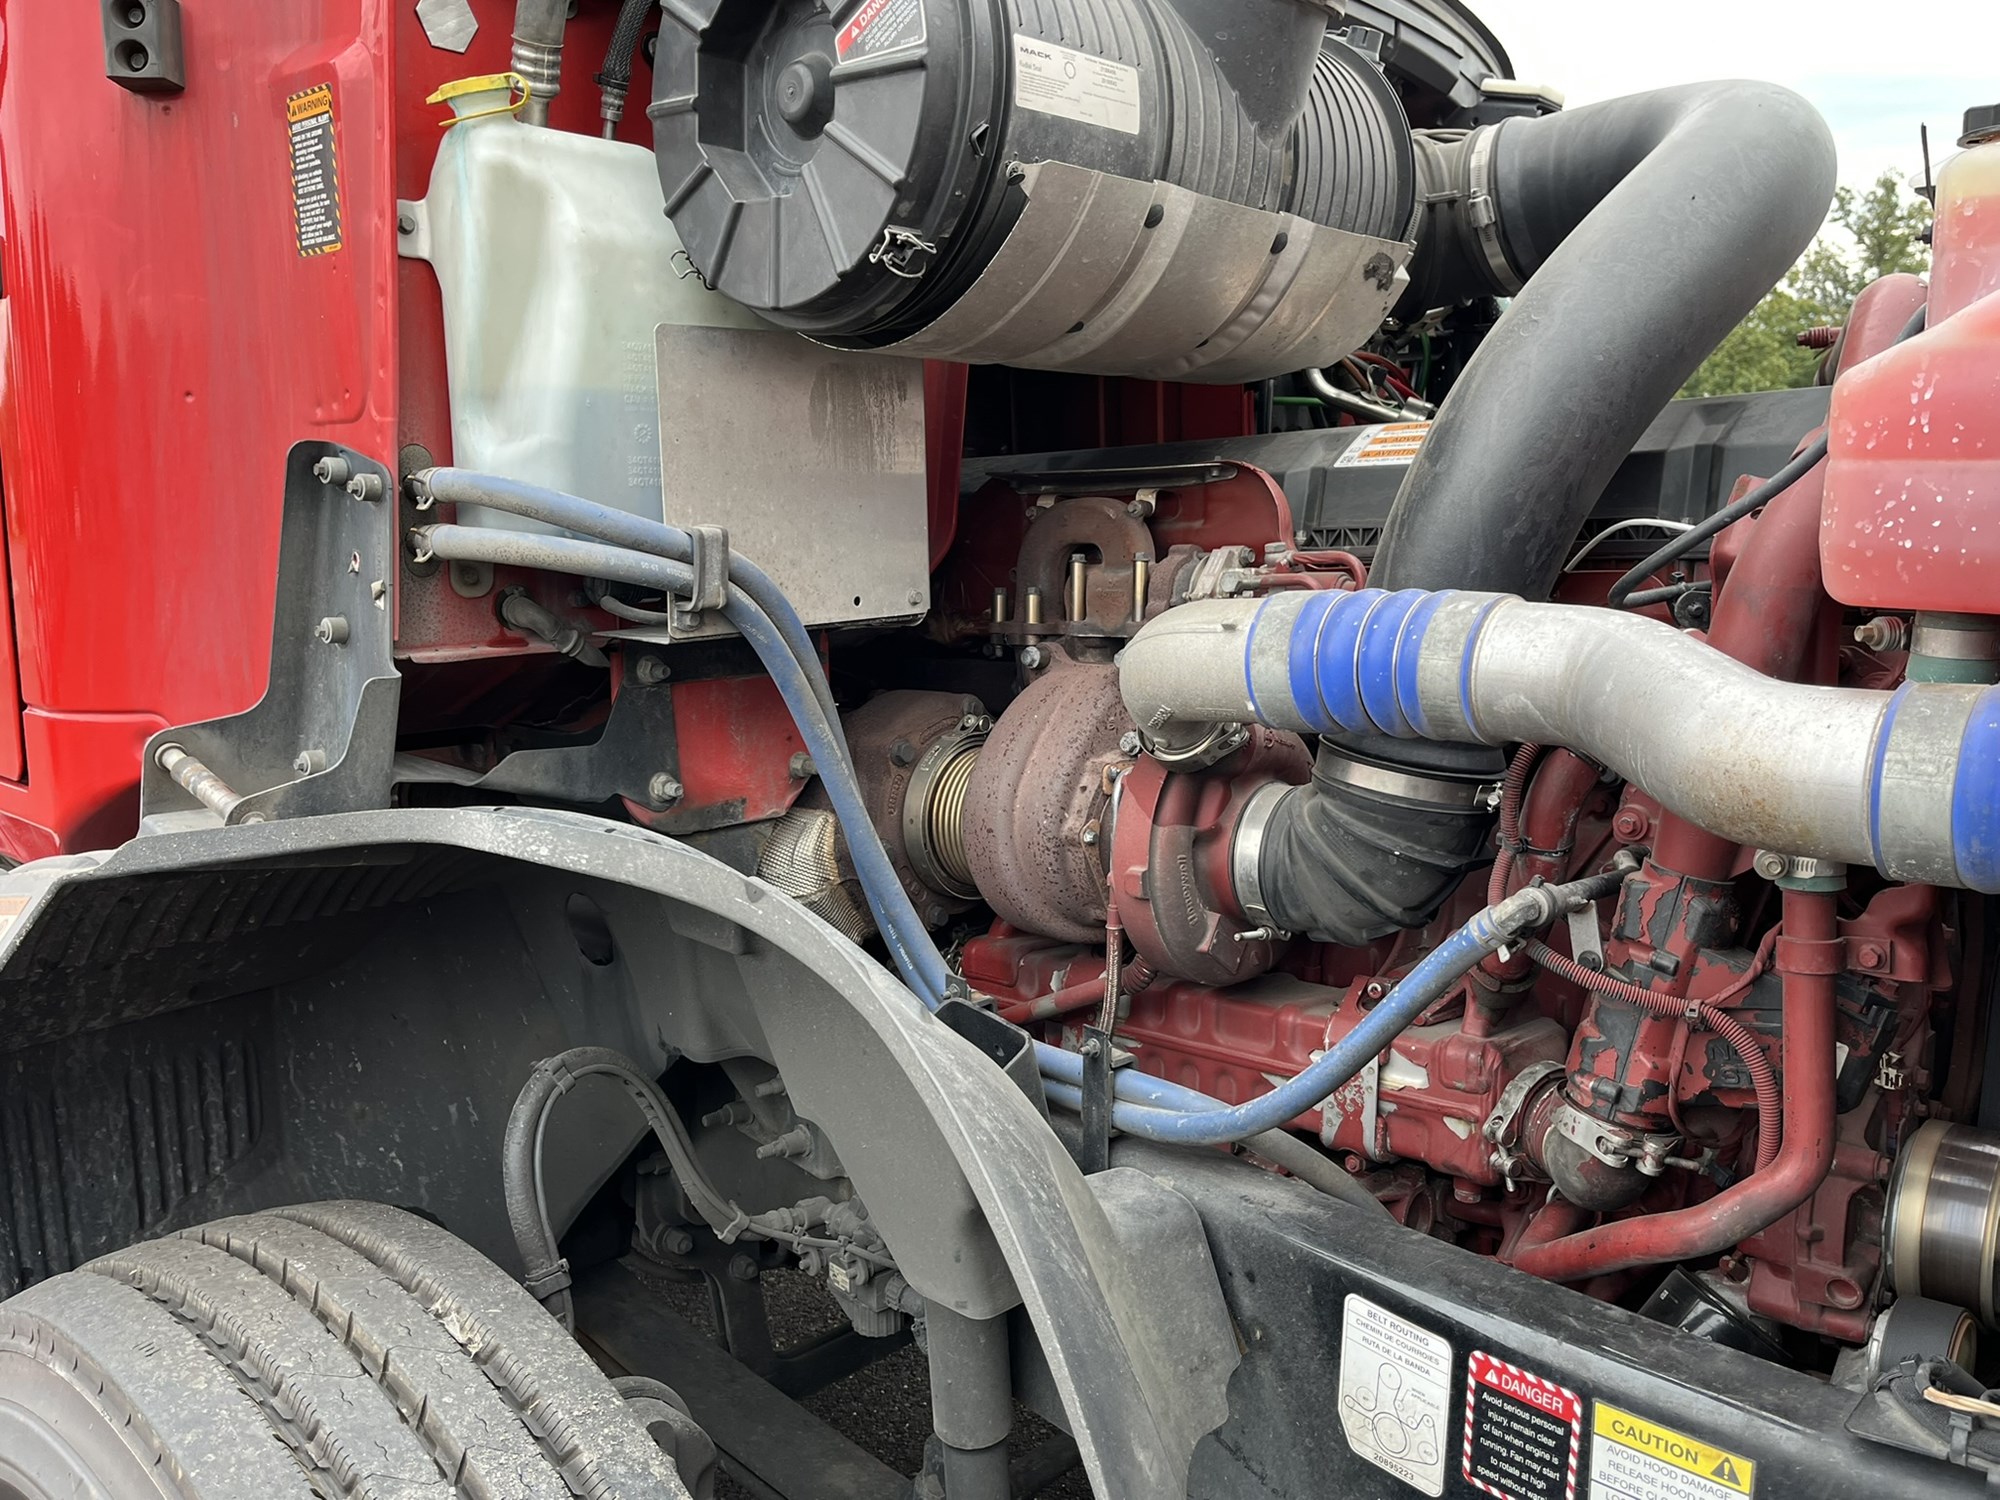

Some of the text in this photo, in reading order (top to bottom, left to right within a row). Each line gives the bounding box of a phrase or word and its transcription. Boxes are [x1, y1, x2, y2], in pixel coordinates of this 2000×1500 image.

[1020, 47, 1052, 60] MACK
[297, 94, 327, 114] WARNING
[1177, 854, 1198, 927] Honeywell
[1356, 1318, 1440, 1366] CHEMIN DE COURROIES
[1367, 1310, 1429, 1347] BELT ROUTING
[1362, 1336, 1431, 1376] RUTA DE LA BANDA
[1482, 1392, 1564, 1436] Avoid serious personal
[1502, 1374, 1563, 1414] DANGER
[1483, 1423, 1559, 1465] of fan when engine is
[1488, 1409, 1556, 1447] injury, remain clear
[1611, 1420, 1698, 1465] CAUTION
[1374, 1453, 1414, 1481] 20895223
[1480, 1437, 1560, 1481] running. Fan may start
[1490, 1456, 1546, 1490] to rotate at high
[1606, 1445, 1732, 1500] AVOID HOOD DAMAGE
[1477, 1465, 1499, 1481] speed
[1500, 1476, 1525, 1495] without
[1599, 1470, 1643, 1497] BEFORE
[1608, 1460, 1695, 1500] RELEASE HOOD
